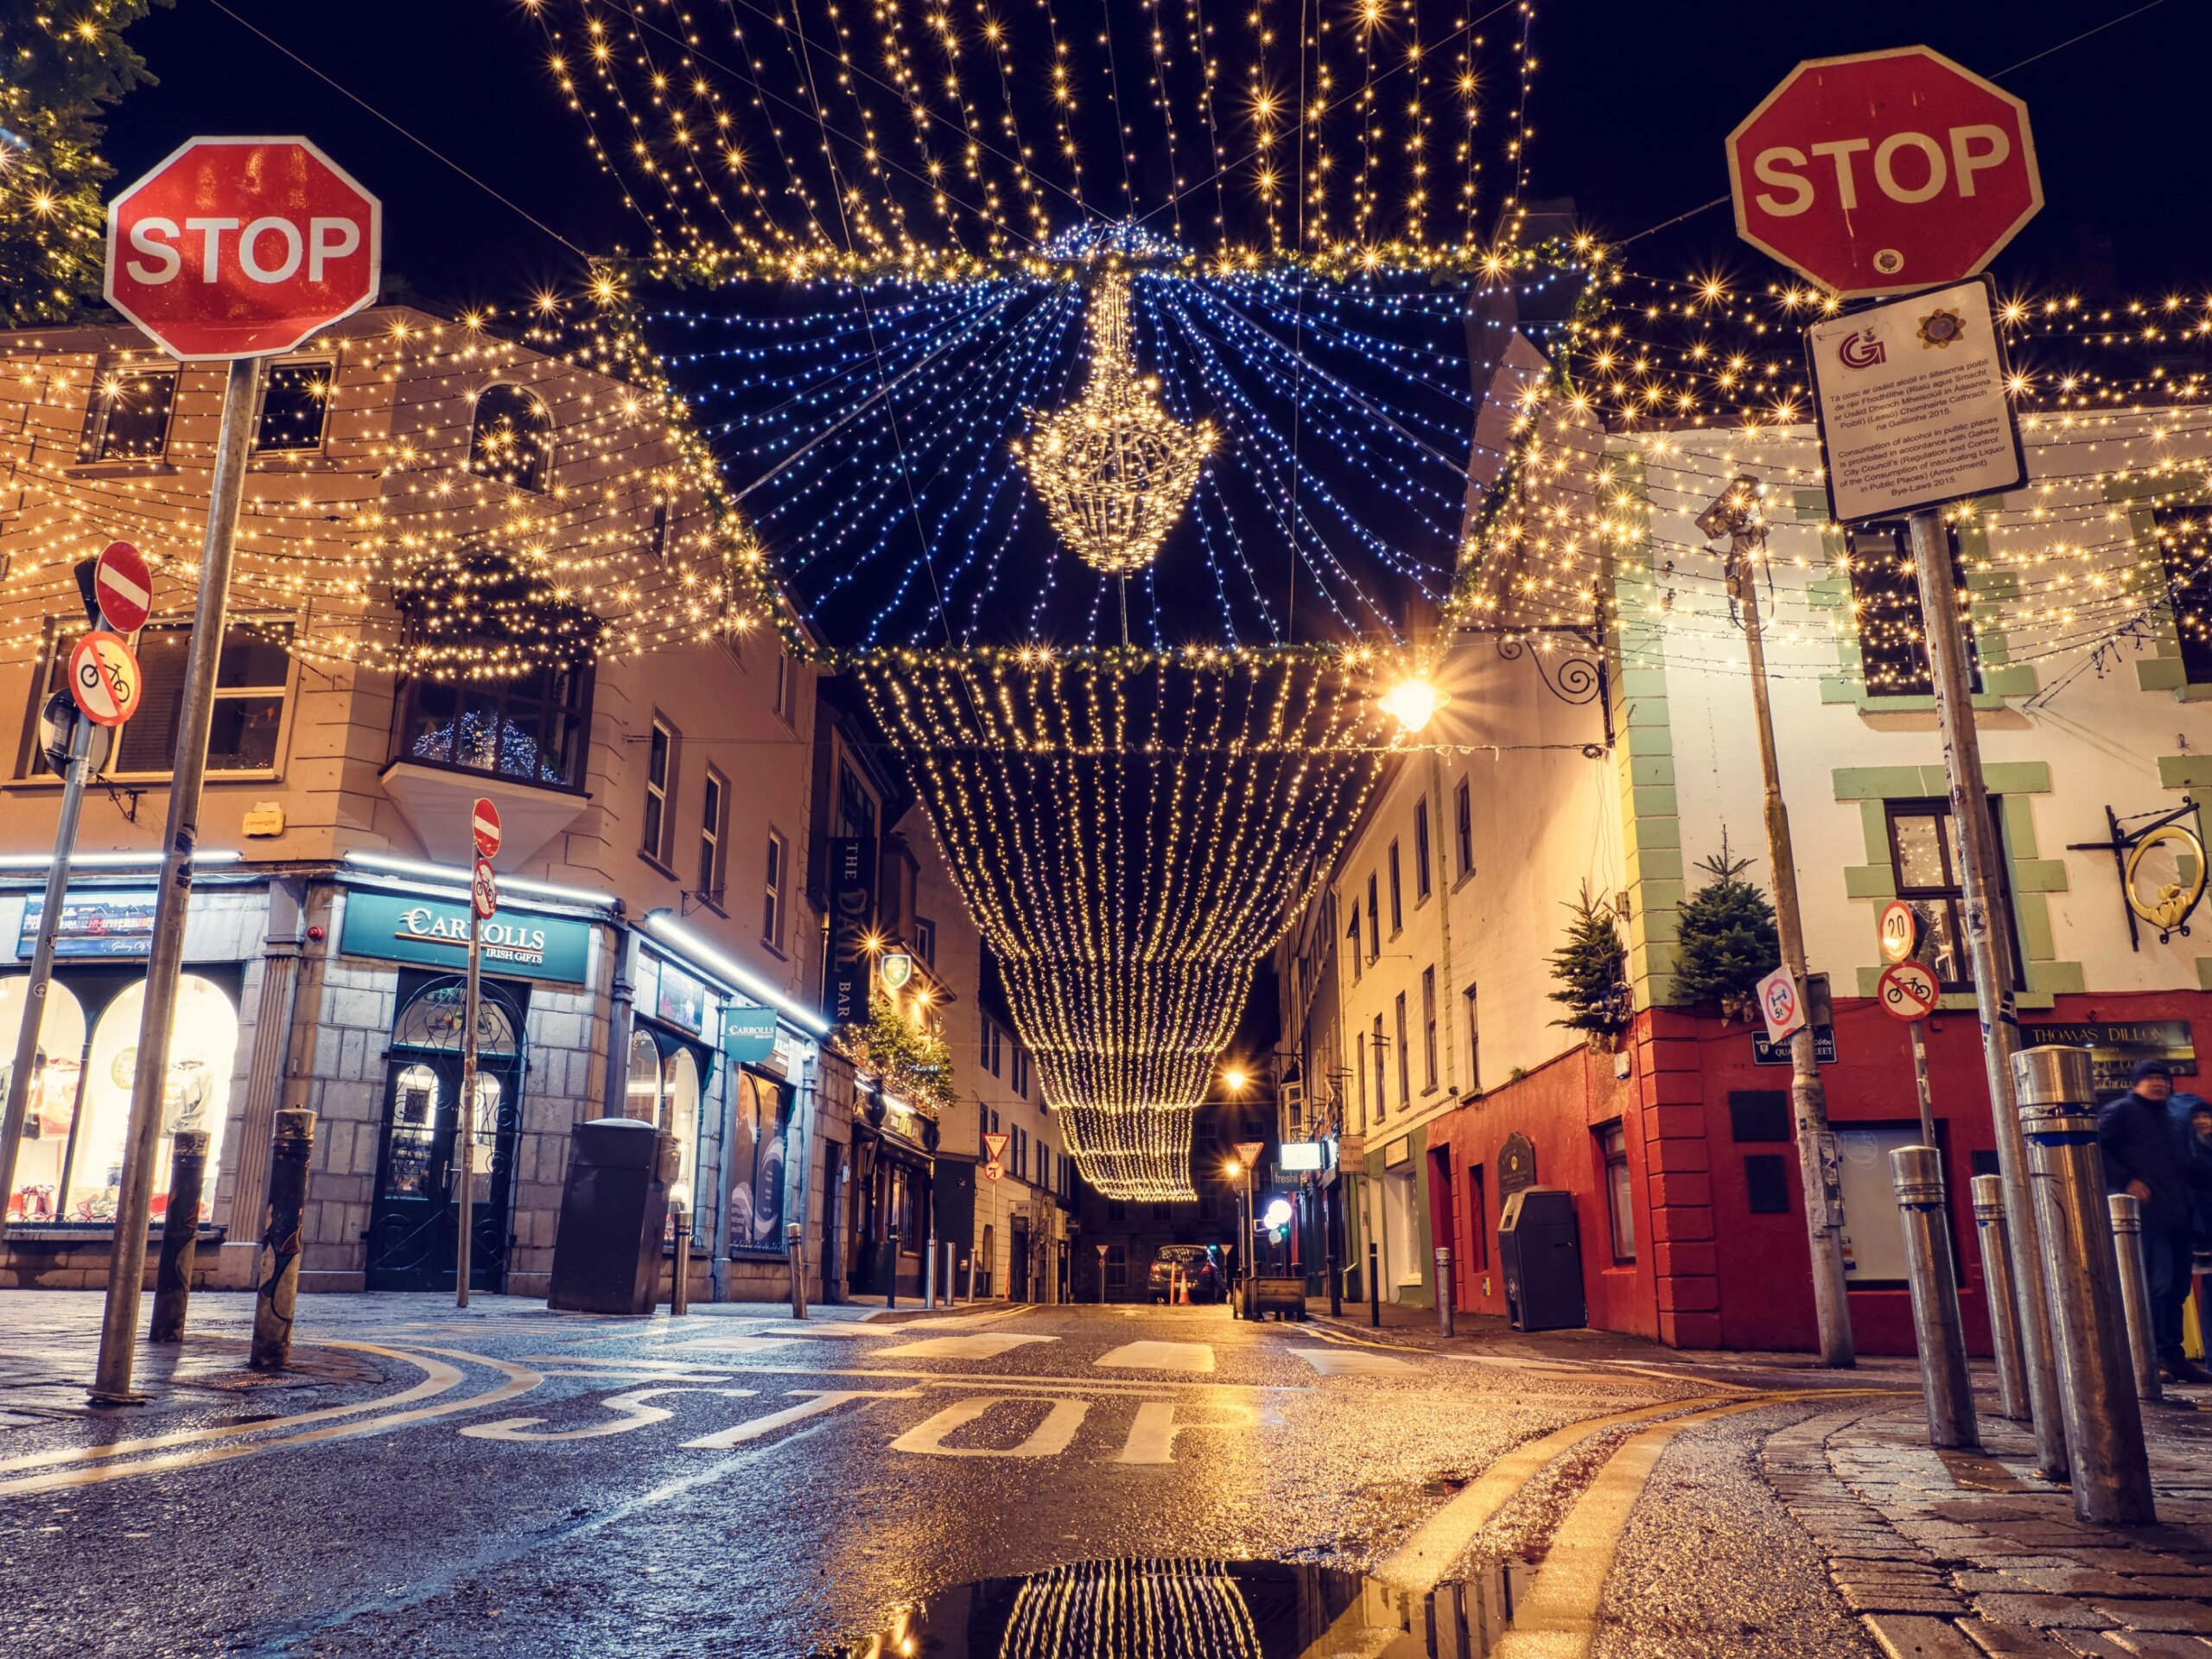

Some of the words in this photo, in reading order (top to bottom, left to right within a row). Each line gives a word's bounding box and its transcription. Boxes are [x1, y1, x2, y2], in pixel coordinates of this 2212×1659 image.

[1753, 124, 2011, 217] STOP
[126, 216, 361, 285] STOP
[1839, 442, 1891, 458] Consumption
[1903, 432, 1932, 444] alcohol
[1944, 423, 1968, 435] public
[1970, 416, 1998, 429] places
[1848, 451, 1887, 467] prohibited
[1899, 439, 1948, 454] accordance
[1949, 434, 1967, 442] with
[1968, 427, 1999, 439] Galway
[1844, 468, 1859, 477] City
[1861, 460, 1897, 474] Council's
[1900, 449, 1948, 465] (Regulation
[1949, 444, 1965, 453] and
[1967, 435, 1999, 449] Control
[1864, 465, 1918, 482] Consumption
[1920, 461, 1929, 470] of
[1930, 451, 1977, 467] intoxicating
[1979, 445, 2006, 456] Liquor
[1870, 480, 1895, 491] Public
[1897, 472, 1929, 484] Places)
[1930, 459, 1987, 479] (Amendment)
[1891, 482, 1932, 496] Bye-Laws
[844, 842, 859, 880] THE
[486, 948, 513, 960] IRISH
[514, 951, 543, 963] GIFTS
[837, 981, 852, 1018] BAR
[728, 1025, 774, 1035] CARROLLS
[2031, 1028, 2099, 1042] THOMAS
[459, 1388, 1255, 1465] STOP
